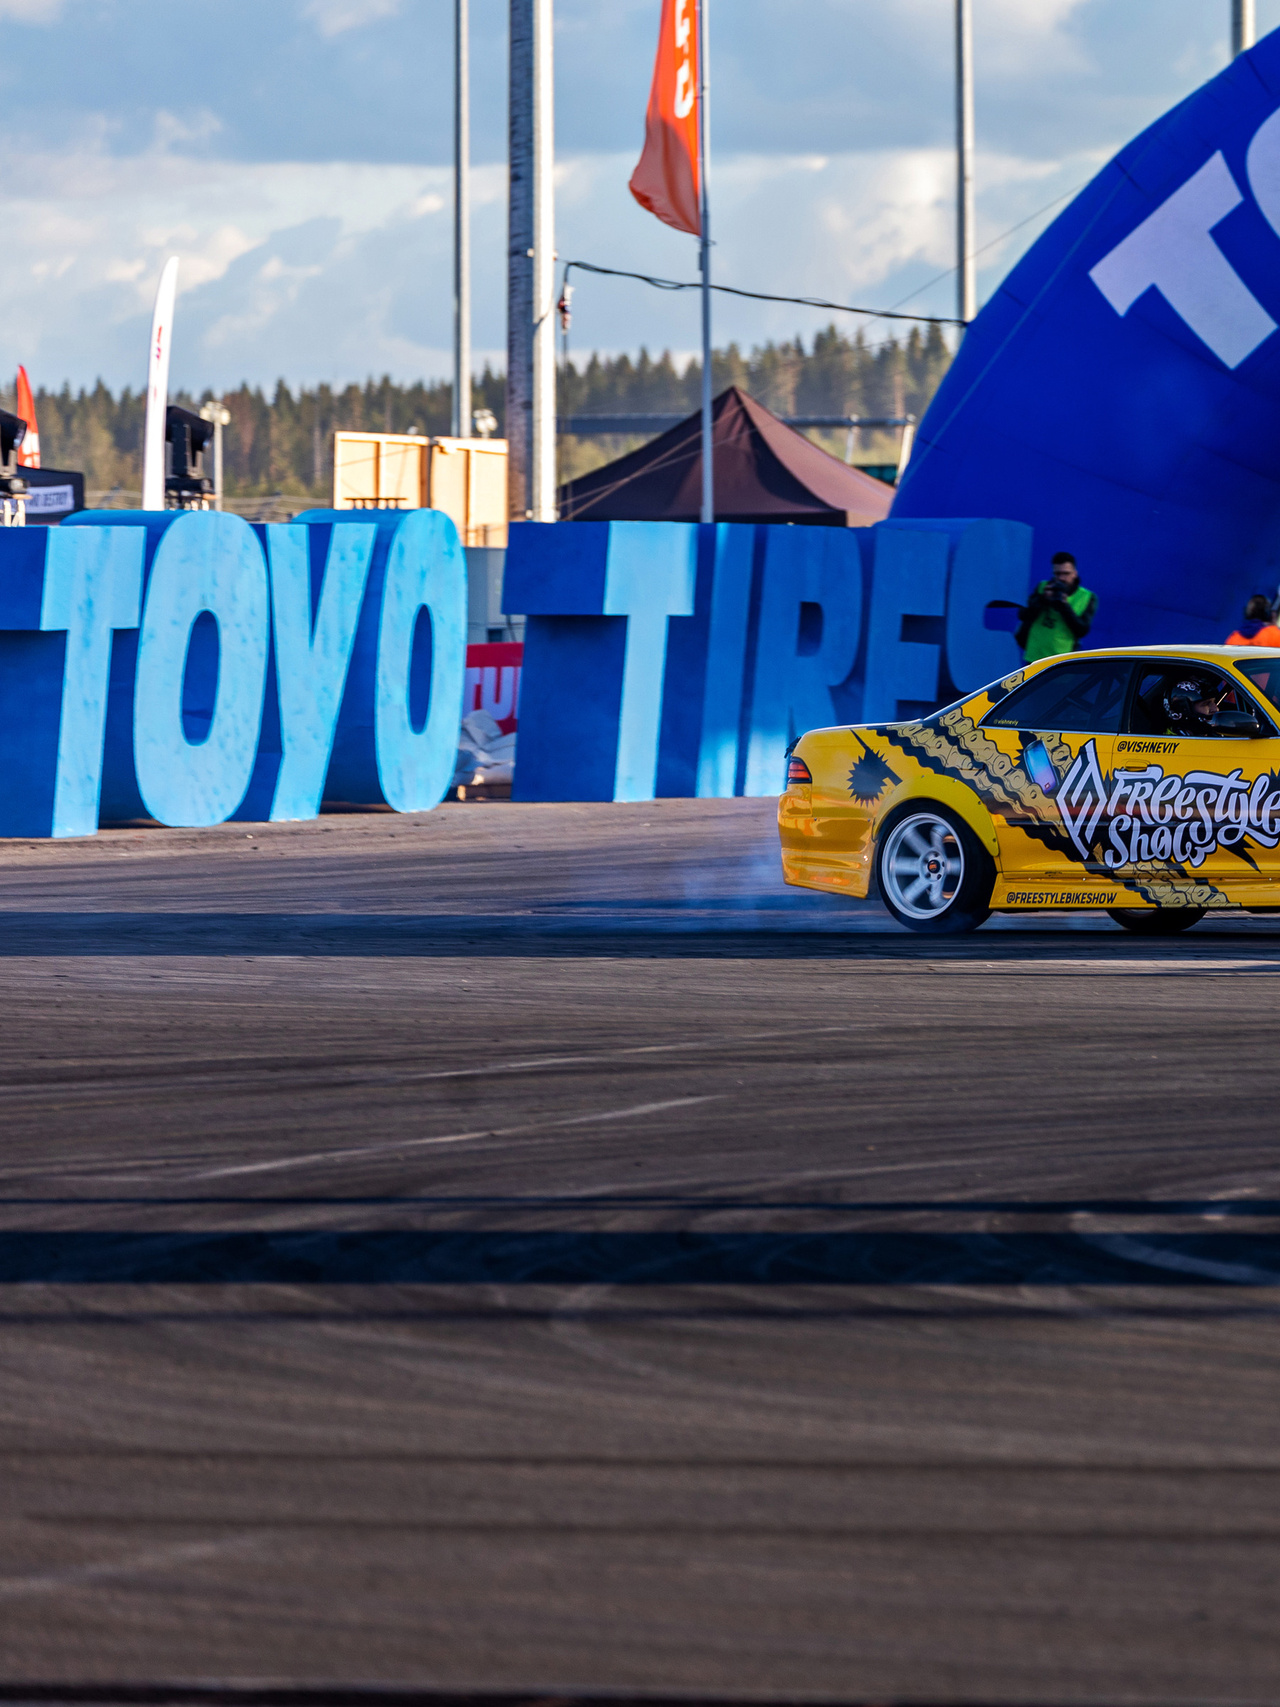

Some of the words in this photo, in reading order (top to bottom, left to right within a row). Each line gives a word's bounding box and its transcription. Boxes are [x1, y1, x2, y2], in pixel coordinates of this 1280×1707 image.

[40, 508, 468, 838] TOYO
[603, 518, 1033, 803] TIRES
[1116, 740, 1181, 754] @VISHNEVIY
[1104, 814, 1217, 868] Show
[1006, 891, 1117, 904] @FREESTYLEBIKESHOW
